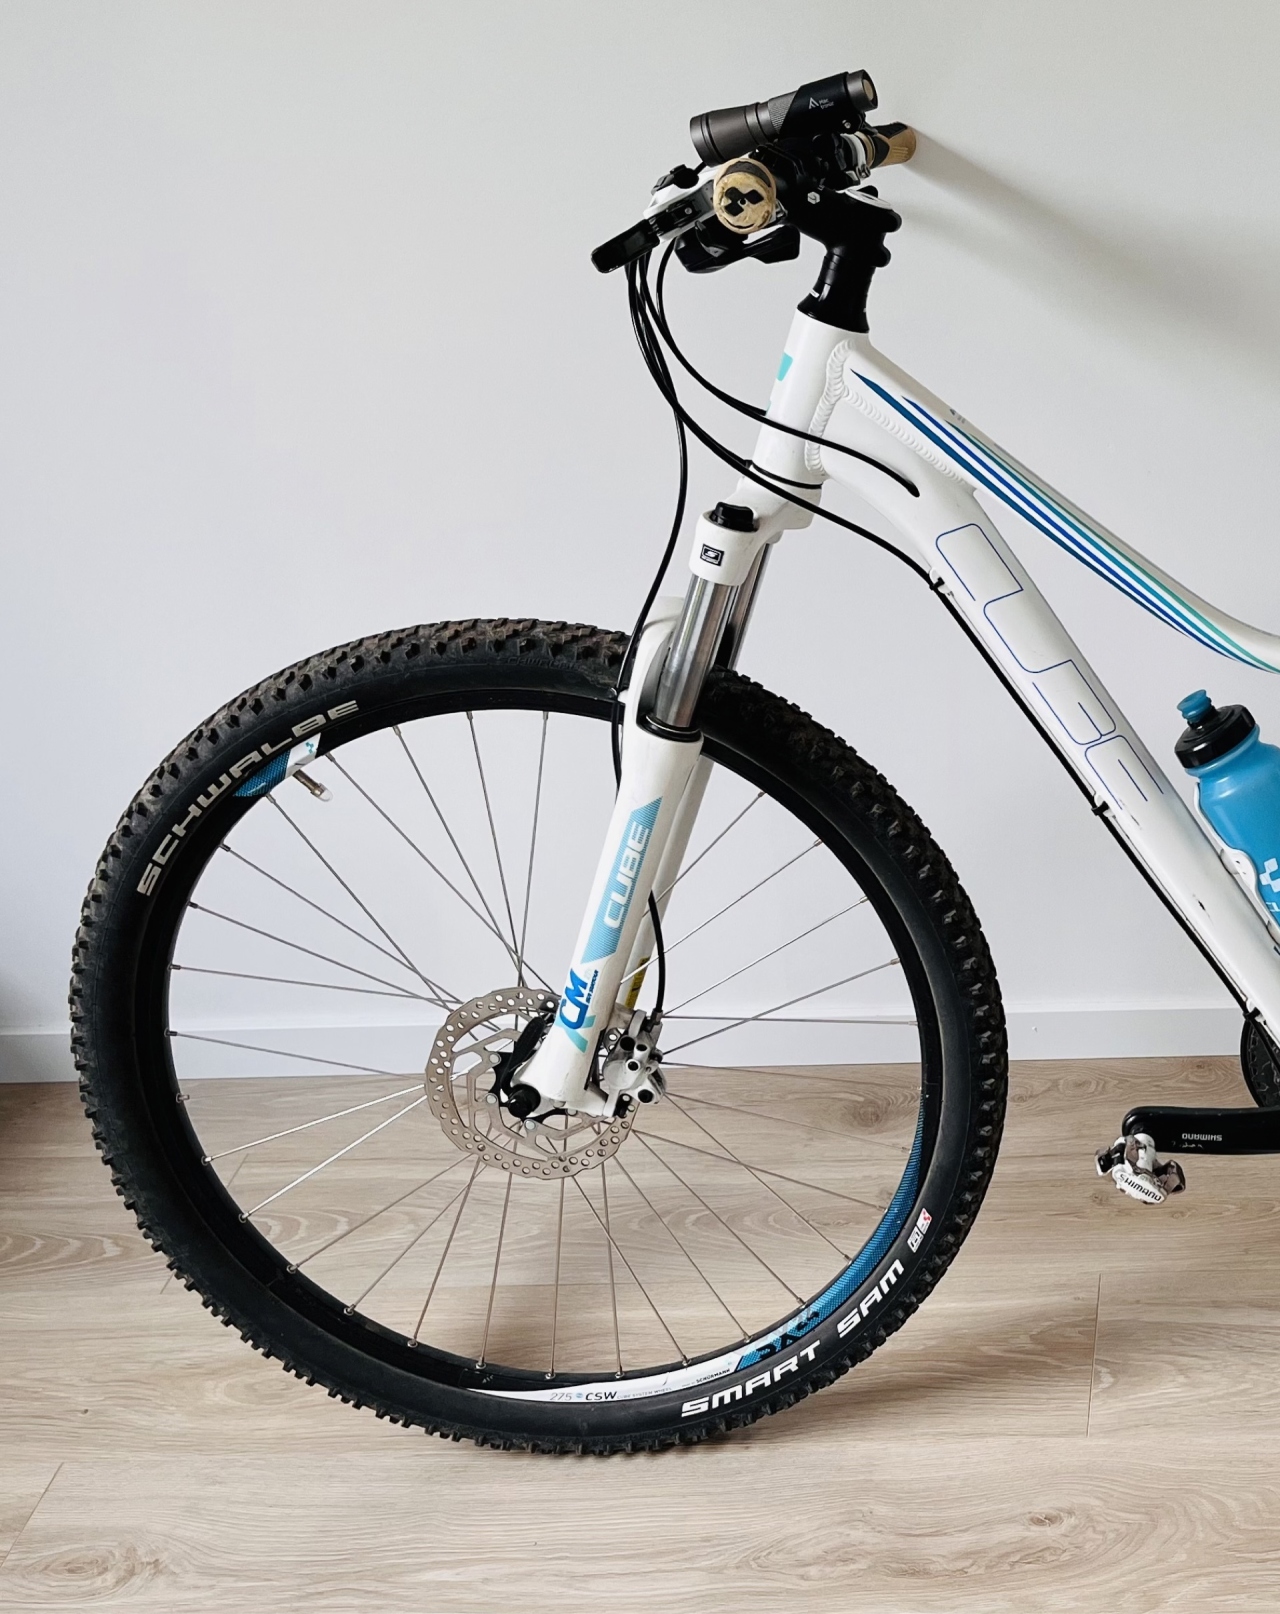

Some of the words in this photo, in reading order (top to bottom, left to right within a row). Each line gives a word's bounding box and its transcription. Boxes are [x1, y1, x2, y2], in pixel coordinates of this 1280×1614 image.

[136, 699, 360, 897] SCHWALBE
[603, 820, 650, 929] CUBE
[1181, 1132, 1222, 1141] SHIMANO
[1119, 1173, 1162, 1202] SHIMANO
[681, 1339, 821, 1418] SMART
[836, 1258, 905, 1339] SAM
[585, 1390, 618, 1401] CSW
